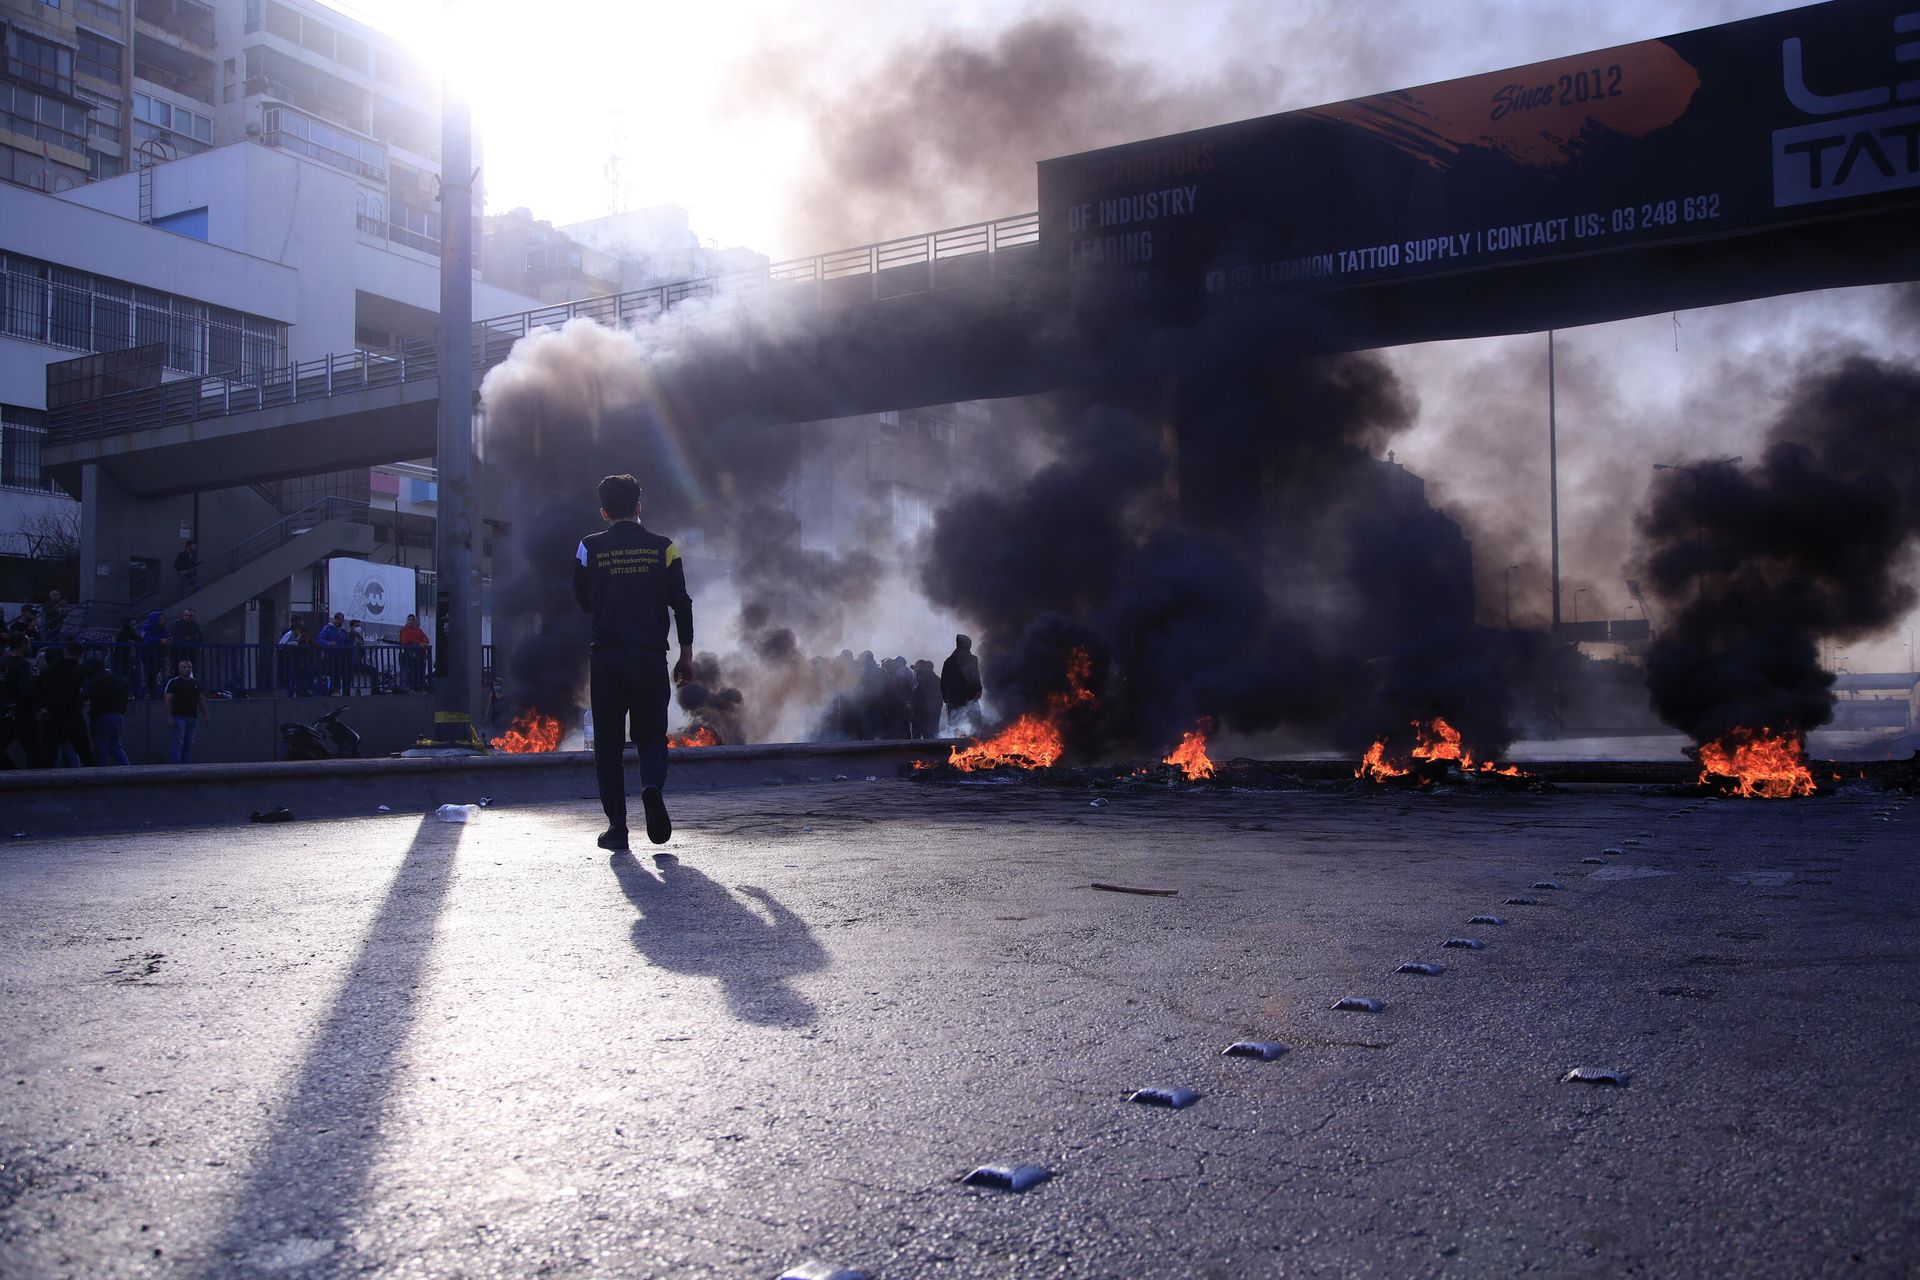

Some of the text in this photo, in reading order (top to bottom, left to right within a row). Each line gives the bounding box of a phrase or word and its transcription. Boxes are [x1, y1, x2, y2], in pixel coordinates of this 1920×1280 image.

[1490, 64, 1623, 121] Since 2012
[1068, 184, 1199, 232] OF INDUSTRY
[1069, 229, 1153, 272] LEADING
[1261, 254, 1334, 284] LEBANON
[1338, 244, 1399, 273] TATTOO
[1405, 233, 1471, 264] SUPPLY
[1487, 216, 1568, 252] CONTACT
[1575, 213, 1606, 237] US:
[1612, 207, 1635, 232] 03
[1642, 201, 1677, 228] 248
[1684, 193, 1721, 220] 632
